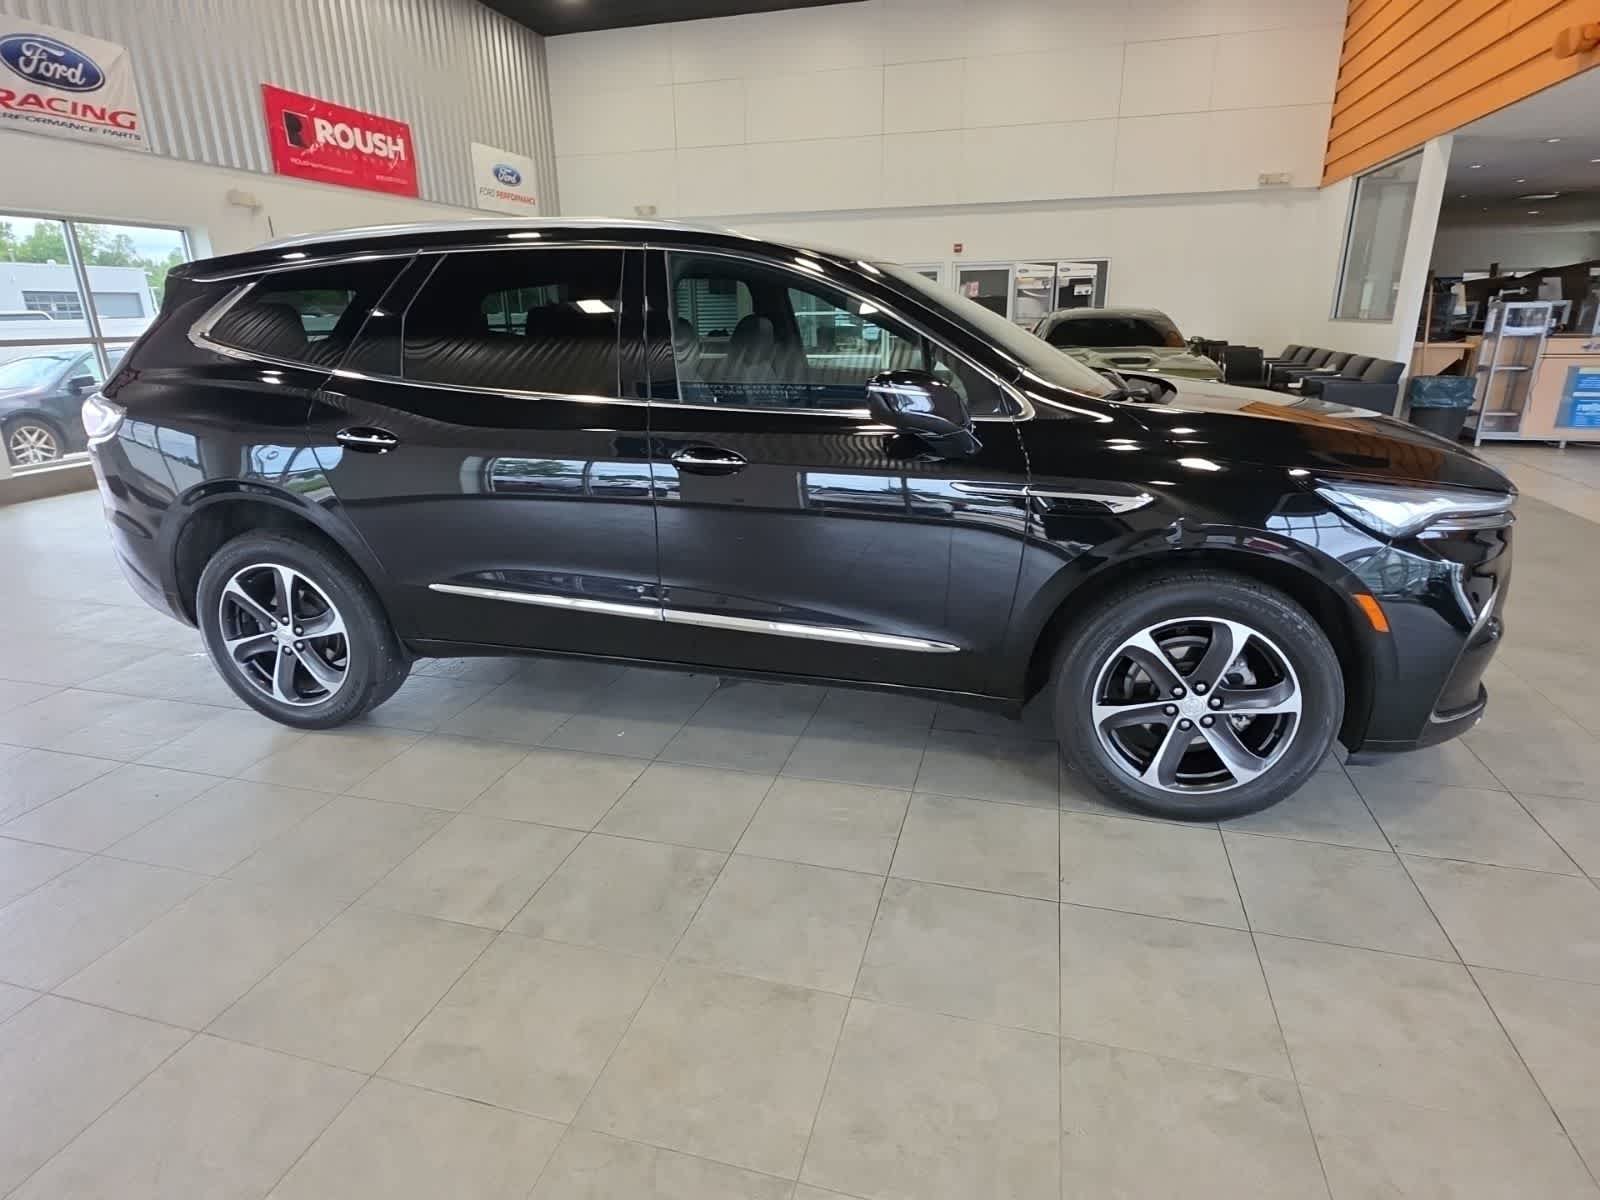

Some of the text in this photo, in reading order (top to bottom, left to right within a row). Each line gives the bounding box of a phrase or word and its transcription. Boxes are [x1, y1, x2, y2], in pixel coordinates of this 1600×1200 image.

[18, 41, 87, 86] Ford
[102, 128, 141, 141] PARTS
[313, 117, 406, 161] ROUSH
